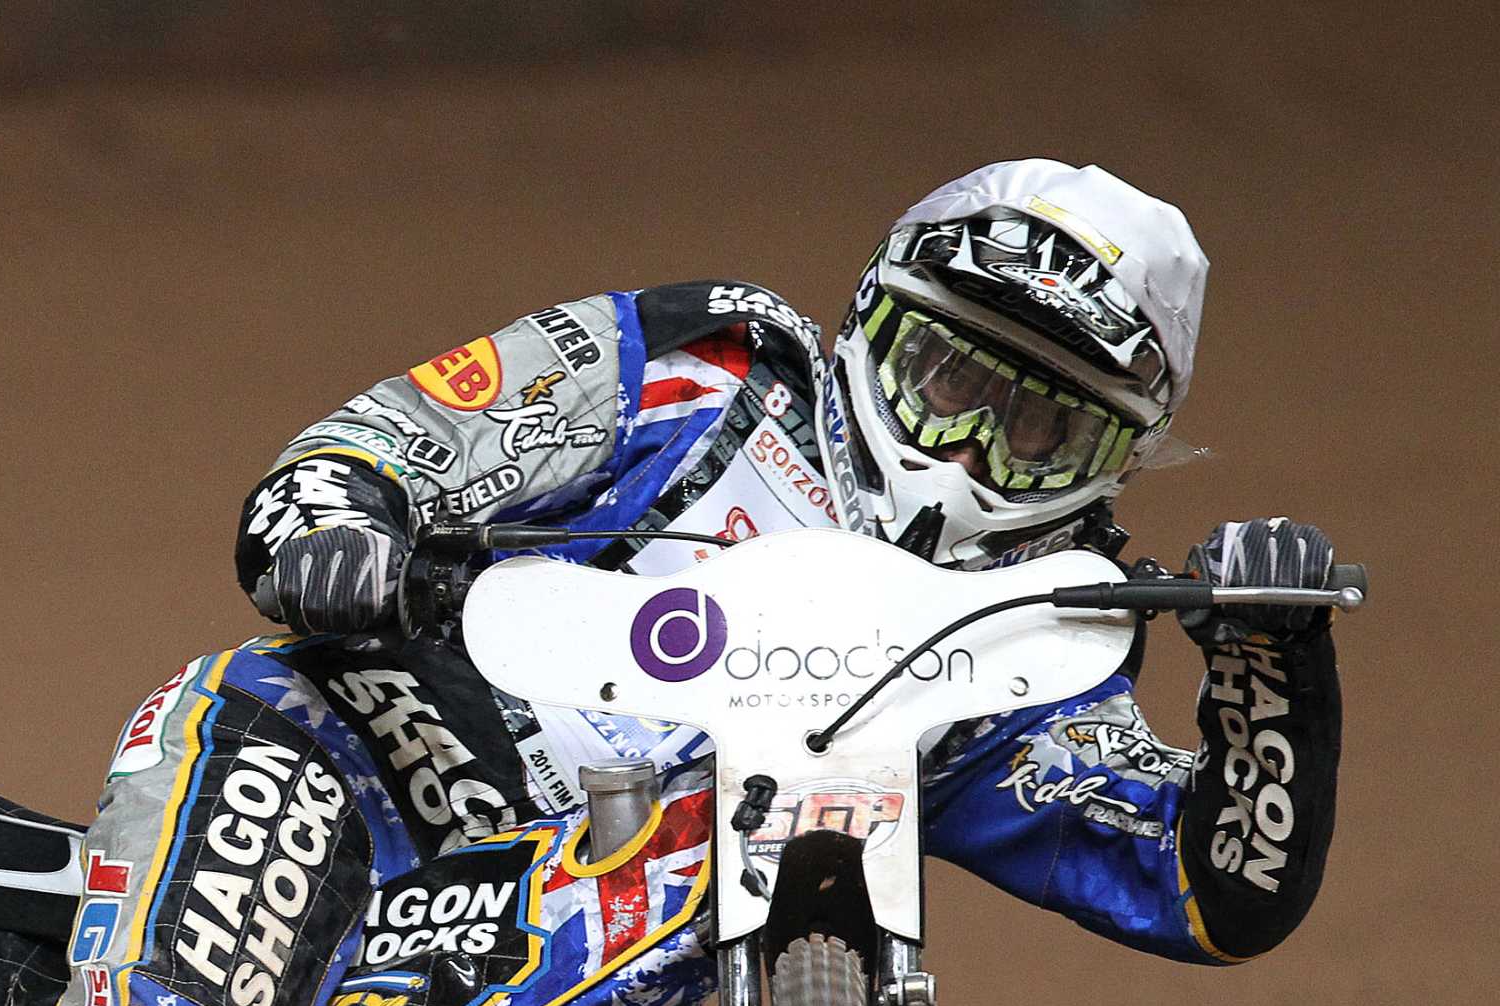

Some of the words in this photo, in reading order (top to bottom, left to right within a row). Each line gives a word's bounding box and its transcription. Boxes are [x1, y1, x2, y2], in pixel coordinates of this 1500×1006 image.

[529, 749, 552, 782] 2011
[549, 777, 575, 808] FIM
[175, 739, 302, 988] HAGON
[360, 922, 498, 966] OCKS
